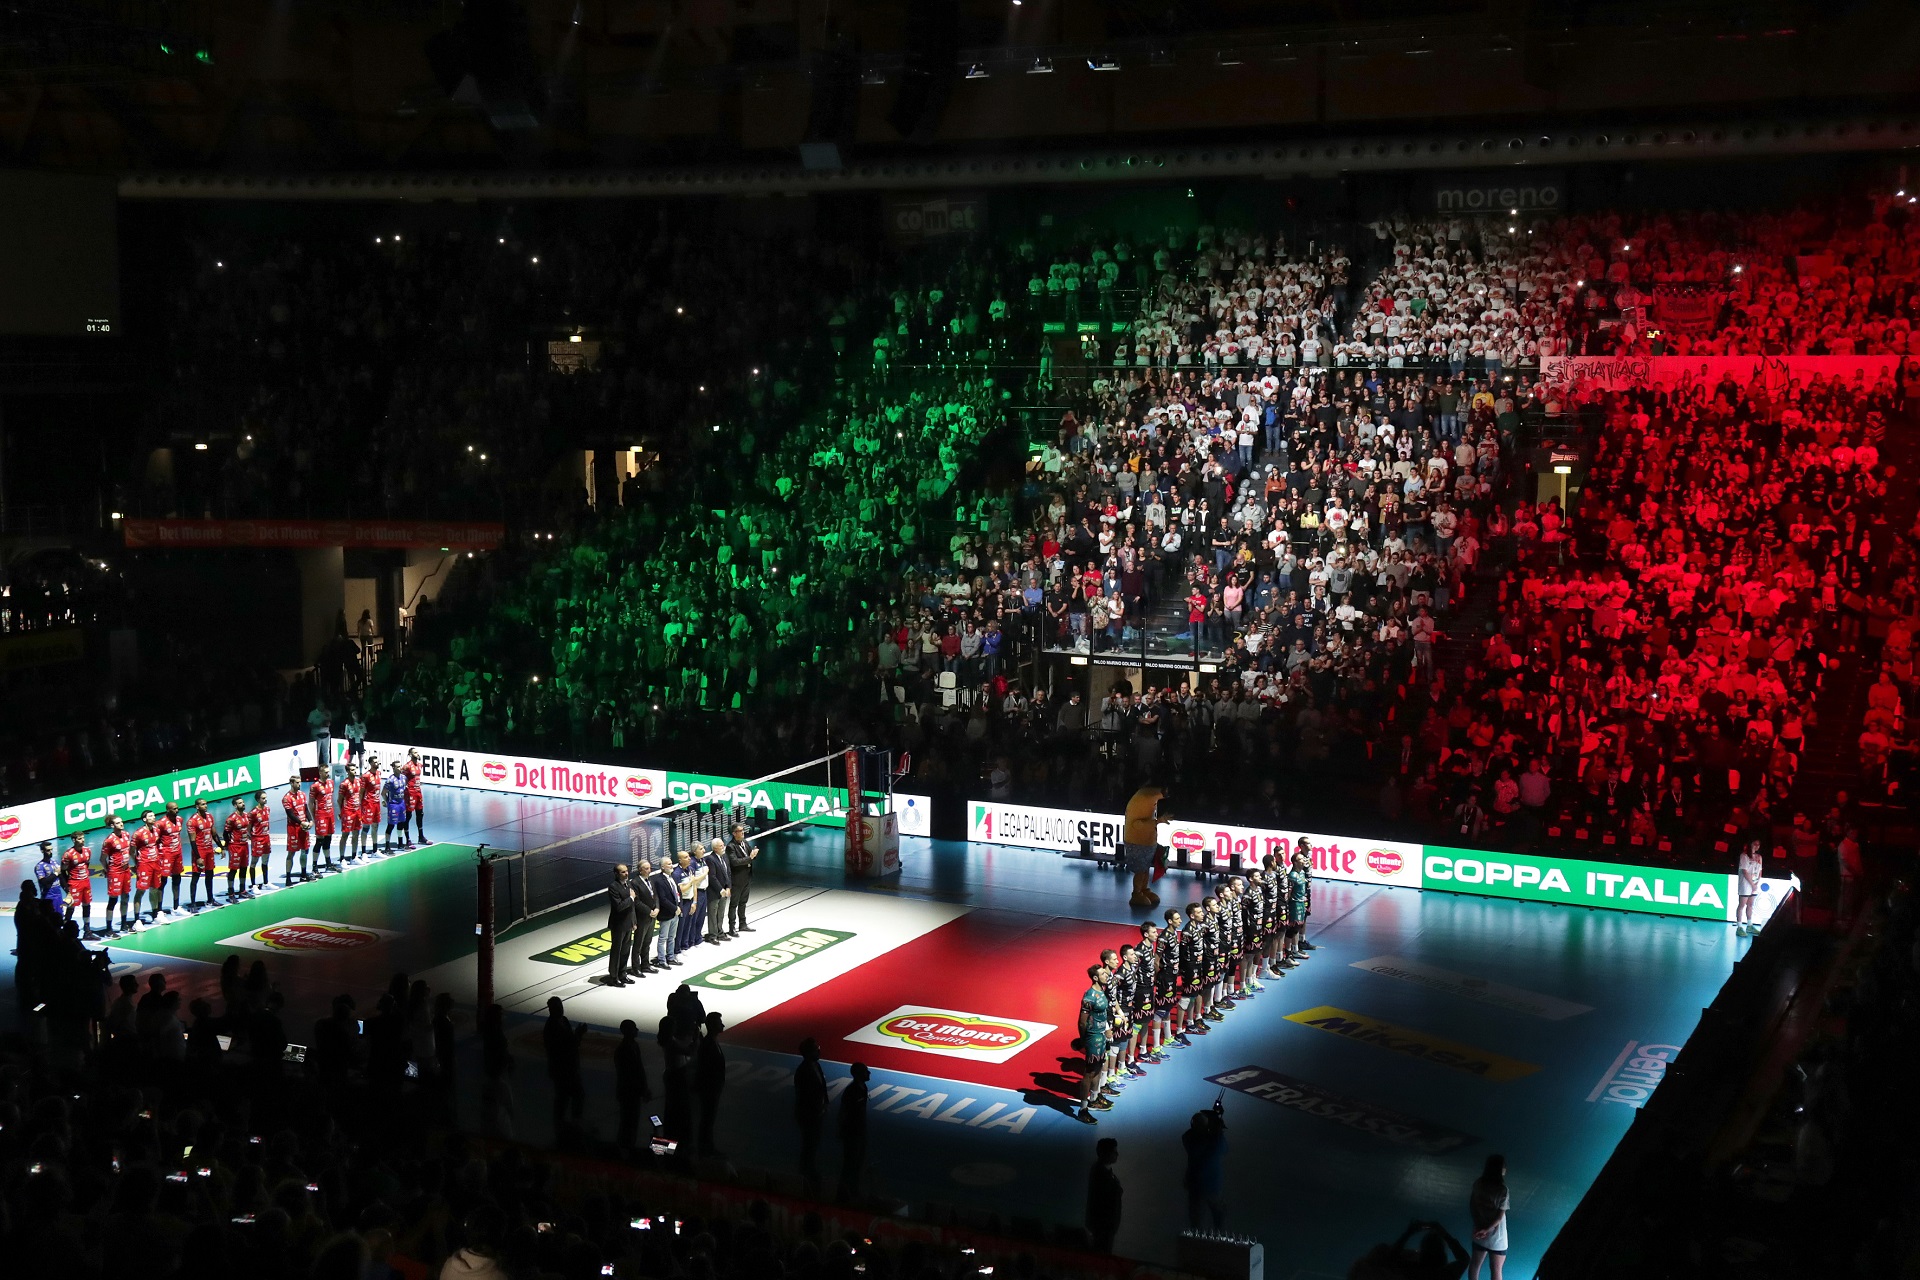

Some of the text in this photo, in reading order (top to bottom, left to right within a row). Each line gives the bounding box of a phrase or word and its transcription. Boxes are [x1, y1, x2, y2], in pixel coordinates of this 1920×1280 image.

[1438, 186, 1559, 208] moreno
[897, 204, 977, 231] comet
[422, 754, 455, 780] ERIE
[460, 758, 469, 781] A
[514, 762, 618, 798] Del Monte
[64, 766, 253, 825] COPPA ITALIA
[668, 781, 881, 817] COPPA ITALA
[999, 812, 1125, 848] LEGA PALLAVOLO SERI
[1173, 836, 1204, 847] Del Monte
[1215, 831, 1357, 874] Del Mnte
[1368, 855, 1403, 867] Del Monte
[1424, 856, 1725, 909] COPPA ITALIA
[269, 927, 365, 946] Del Monte
[704, 930, 839, 986] CREDEM
[894, 1019, 1016, 1044] Del Monte
[914, 1031, 970, 1045] Quality
[1304, 1017, 1490, 1075] MIKASA
[872, 1084, 1038, 1135] ITALIA
[1244, 1081, 1426, 1146] FRASASSI
